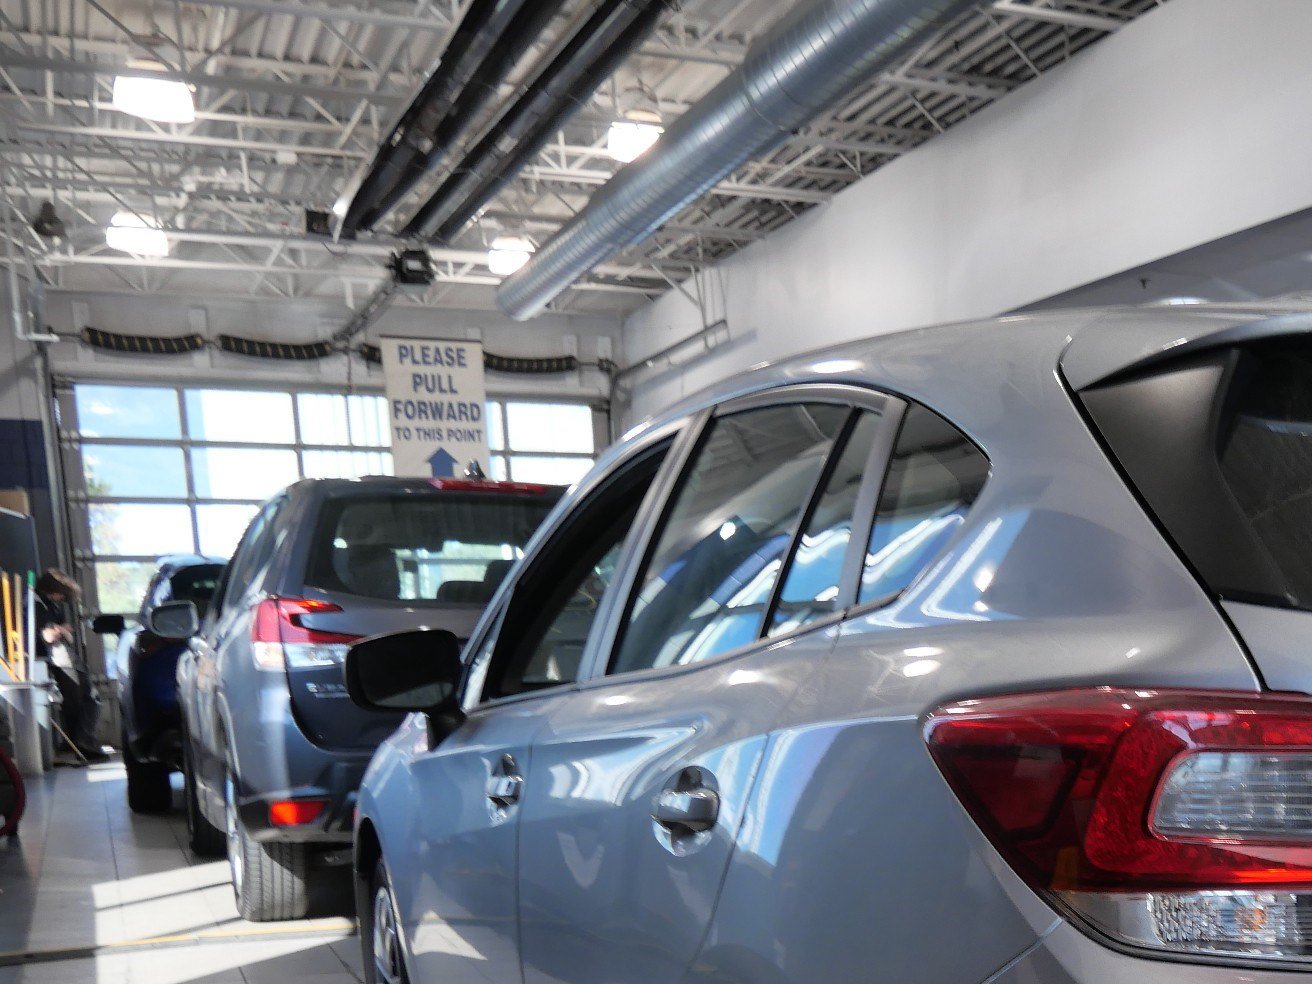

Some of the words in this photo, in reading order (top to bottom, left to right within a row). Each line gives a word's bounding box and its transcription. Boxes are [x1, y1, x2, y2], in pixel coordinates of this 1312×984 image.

[397, 344, 468, 368] PLEASE
[411, 372, 459, 394] PULL
[392, 399, 481, 421] FORWARD
[394, 426, 412, 440] TO
[415, 427, 443, 441] THIS
[446, 428, 483, 442] POINT
